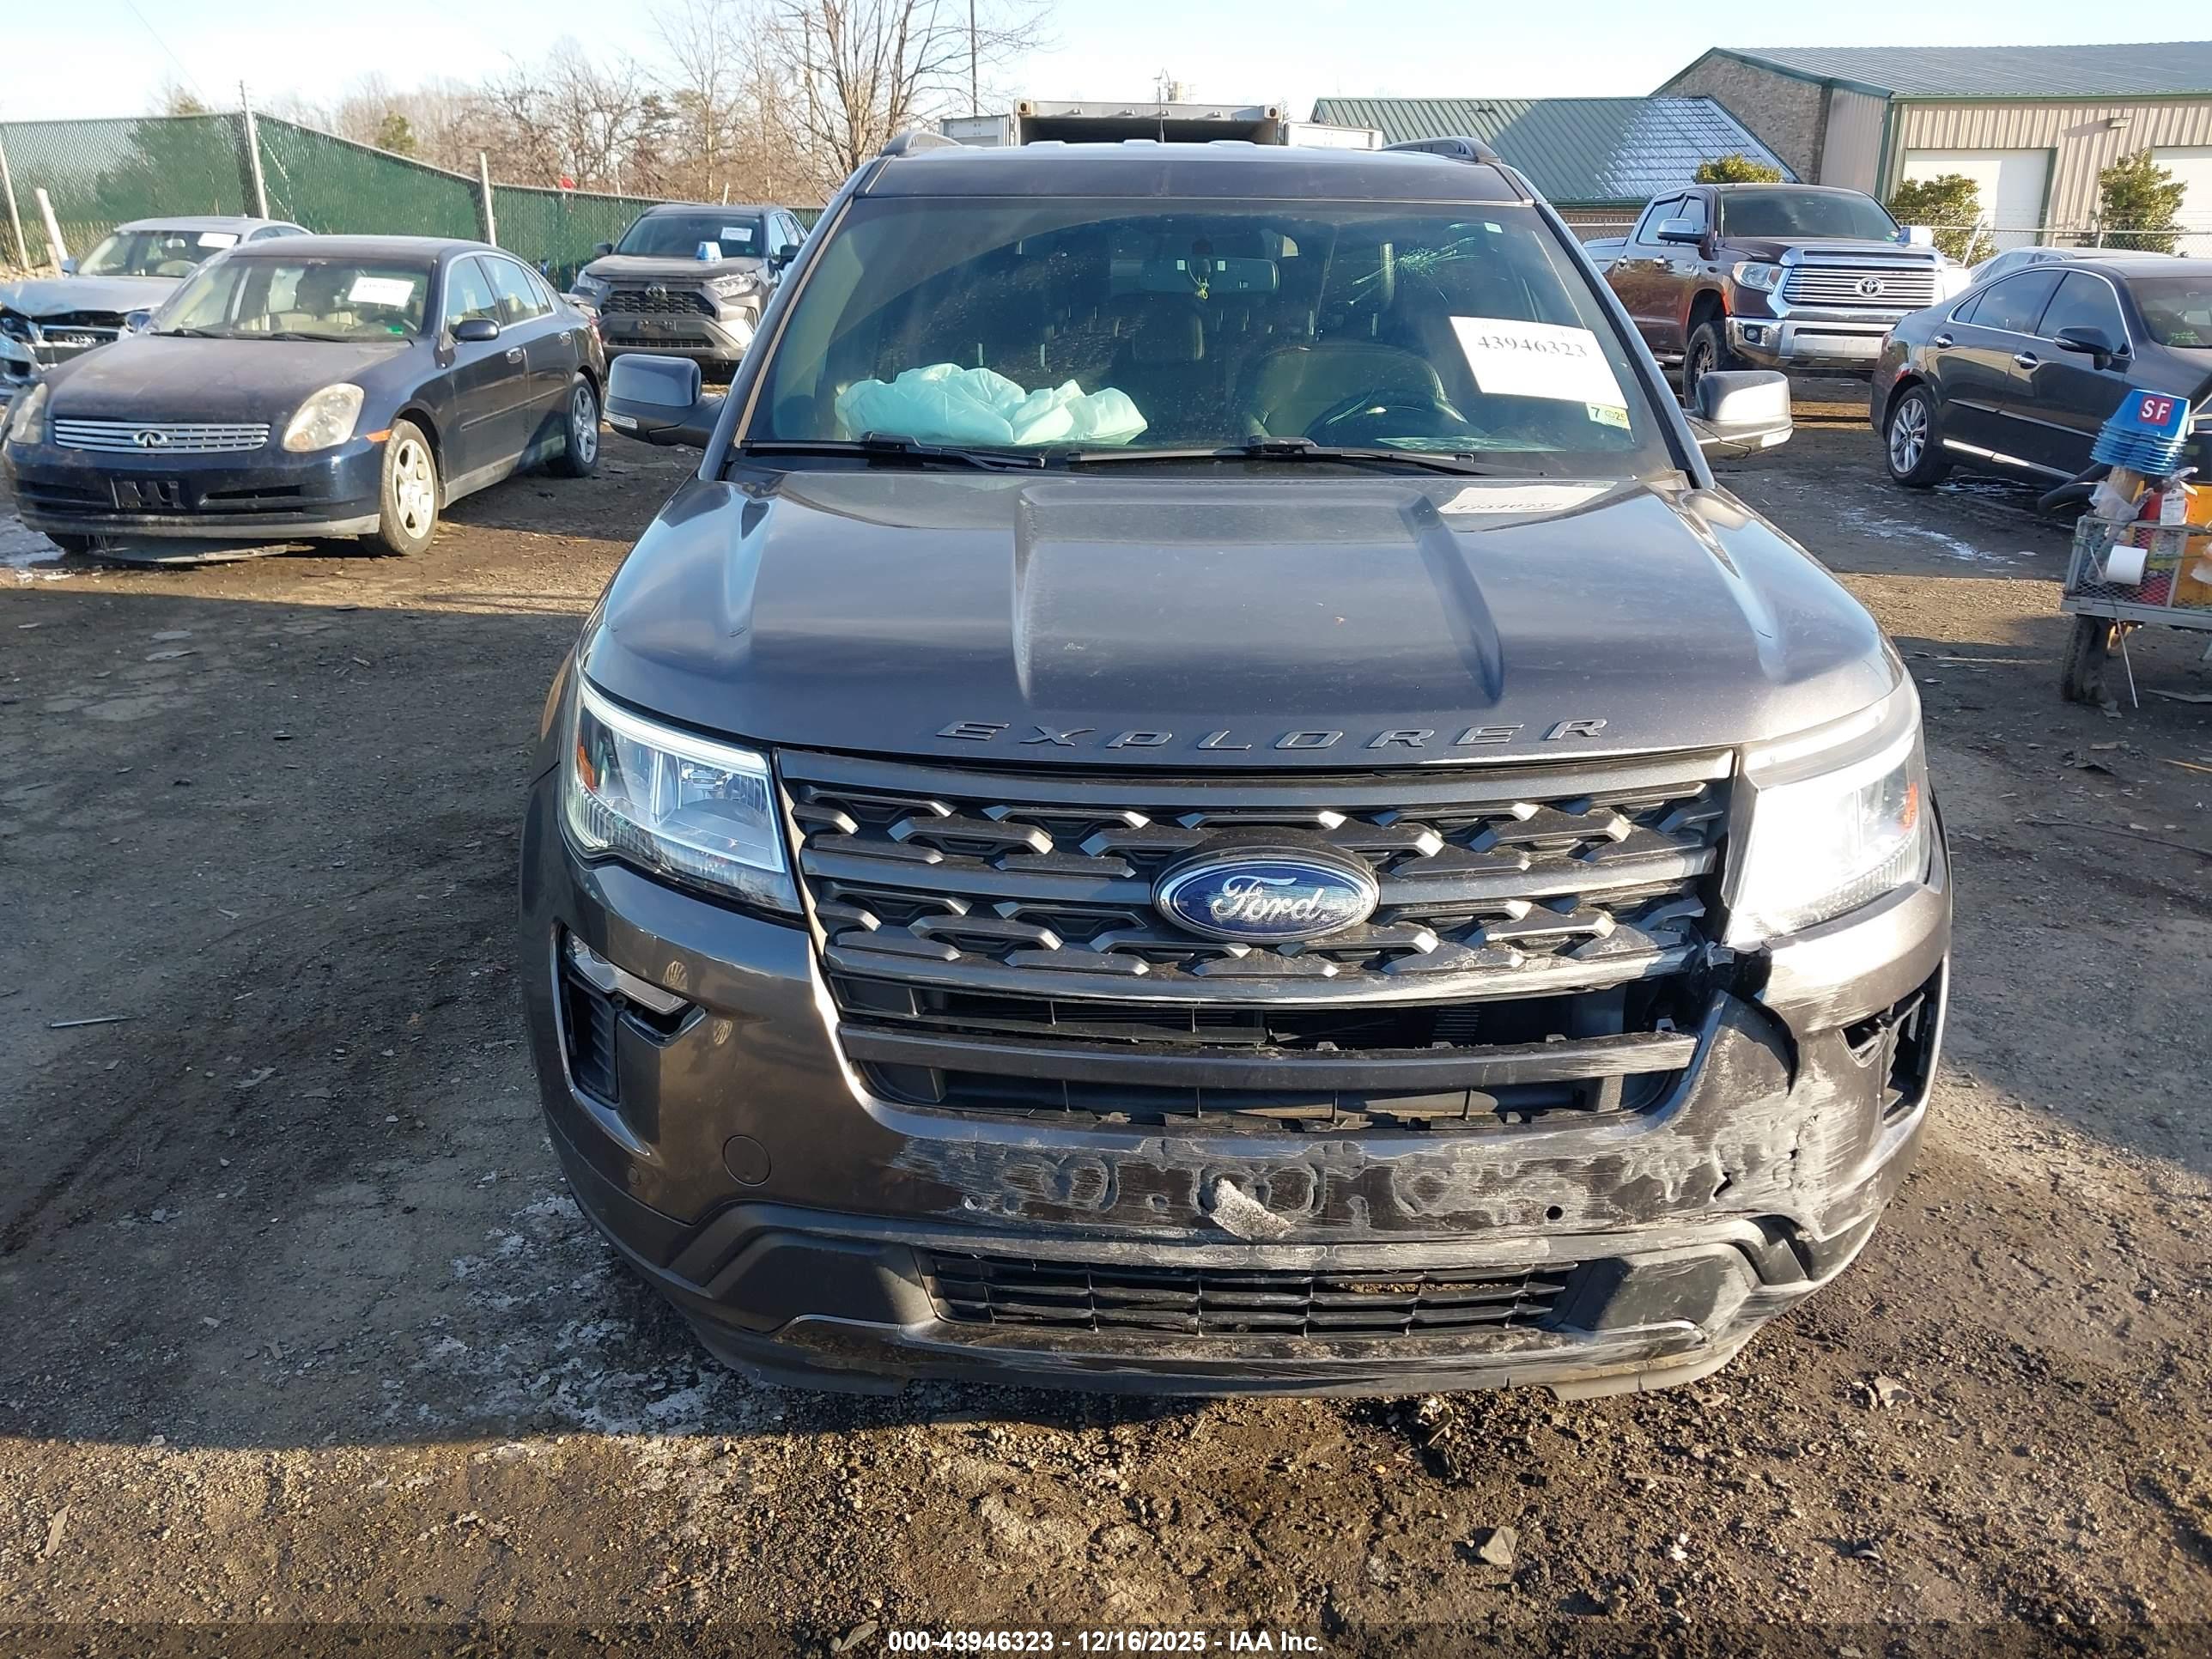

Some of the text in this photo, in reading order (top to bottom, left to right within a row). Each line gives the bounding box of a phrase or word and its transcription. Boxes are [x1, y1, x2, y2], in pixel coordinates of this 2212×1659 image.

[1478, 336, 1587, 357] 43946323
[1590, 406, 1600, 418] 7
[2142, 399, 2170, 420] SF
[934, 717, 1610, 750] EXPLORER
[1210, 874, 1325, 922] Ford
